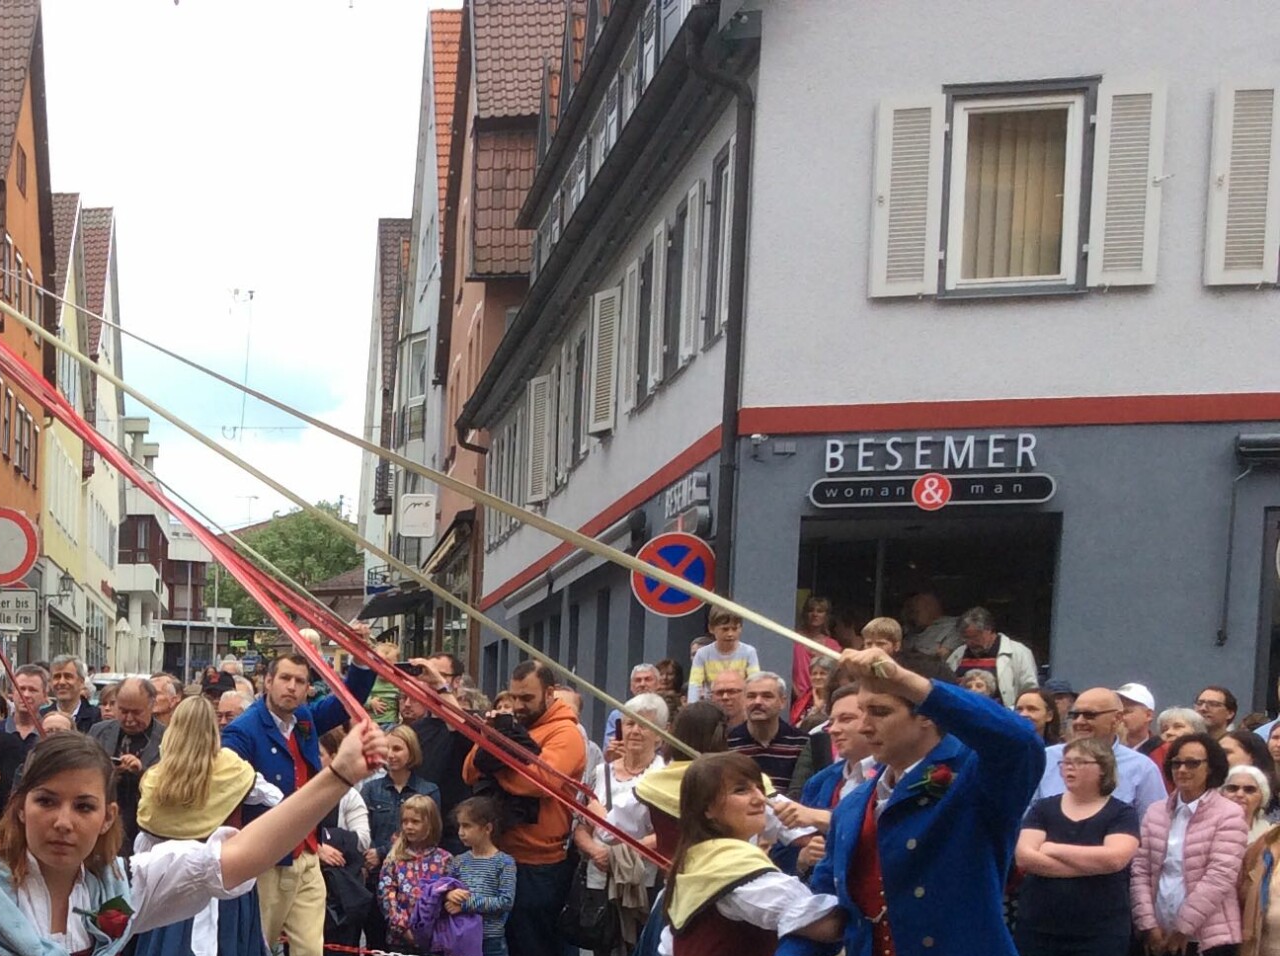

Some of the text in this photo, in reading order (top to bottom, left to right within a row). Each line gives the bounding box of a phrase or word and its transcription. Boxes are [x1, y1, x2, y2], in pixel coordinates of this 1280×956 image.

[825, 432, 1038, 473] BESEMER
[825, 477, 1023, 504] woman & man
[15, 597, 30, 609] bis
[15, 612, 32, 625] frei
